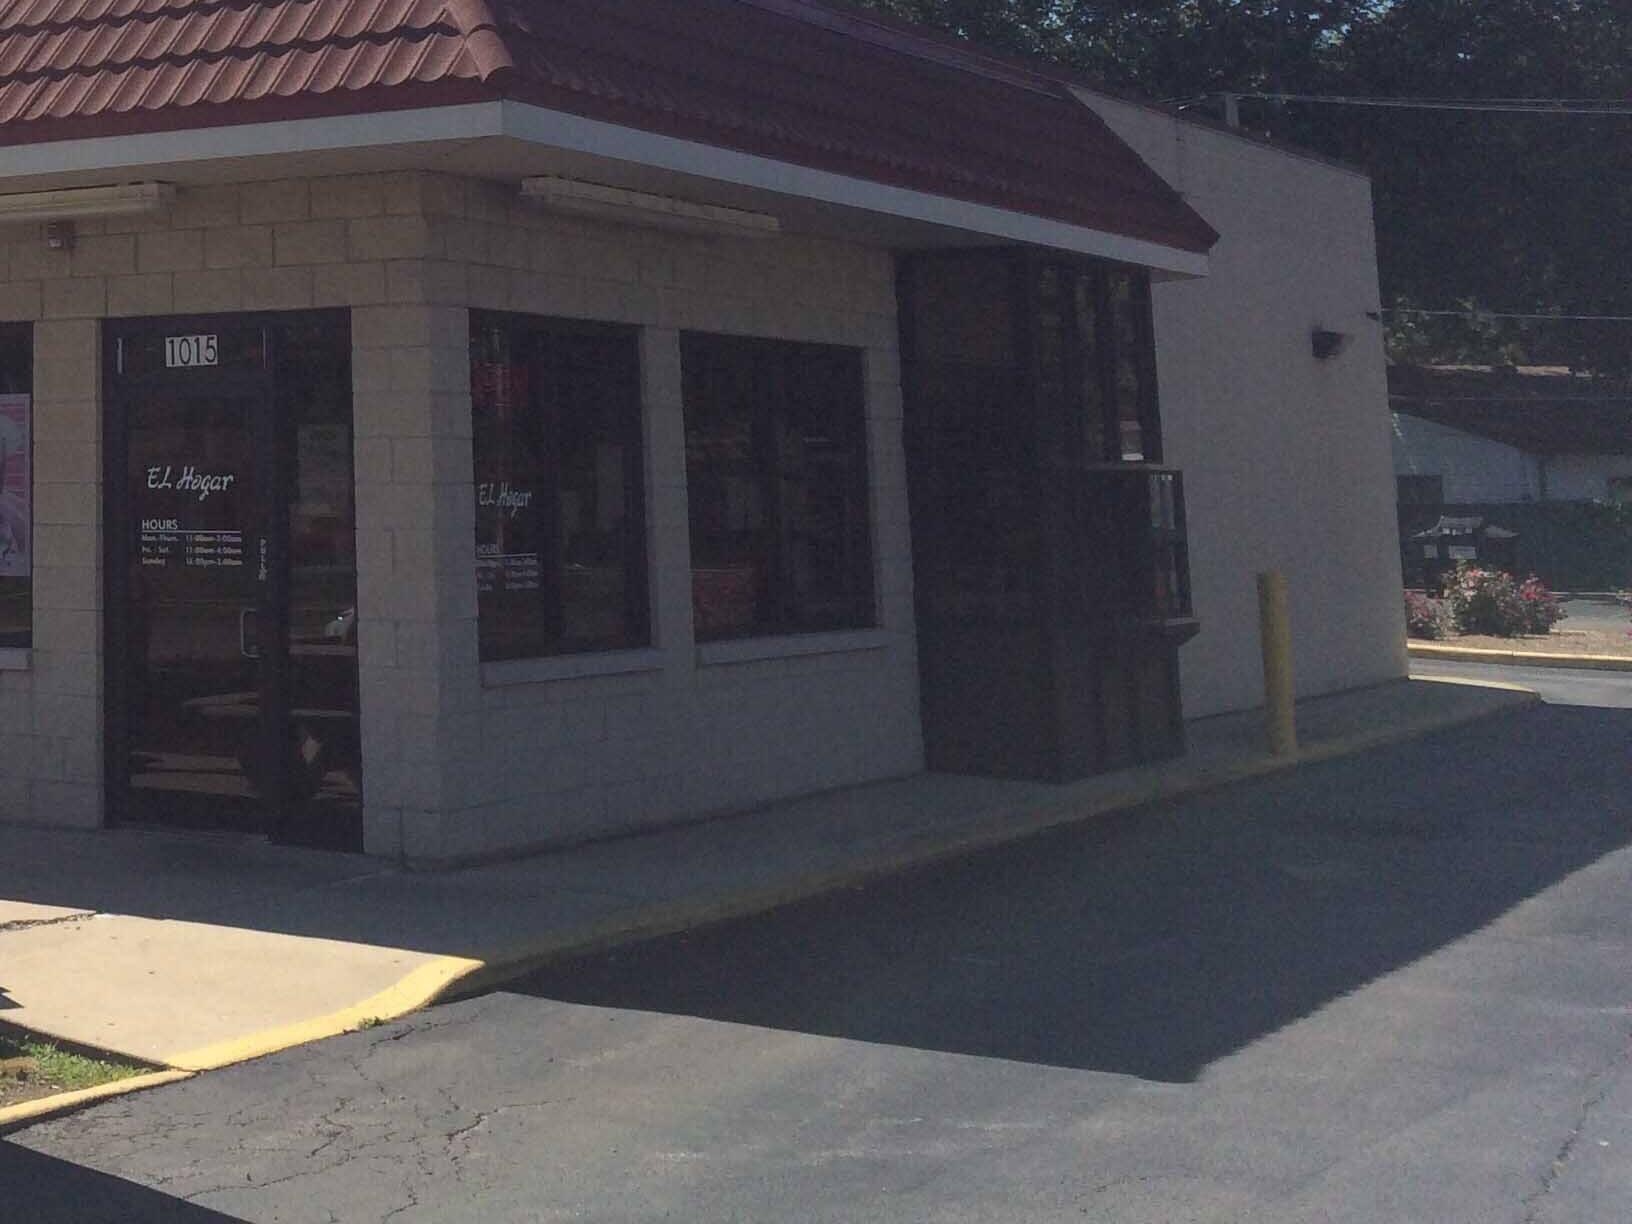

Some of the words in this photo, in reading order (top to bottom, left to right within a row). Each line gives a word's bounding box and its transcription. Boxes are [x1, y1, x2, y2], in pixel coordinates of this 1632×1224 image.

[168, 337, 217, 365] 1015
[176, 466, 234, 501] Hogar
[141, 519, 178, 530] HOURS
